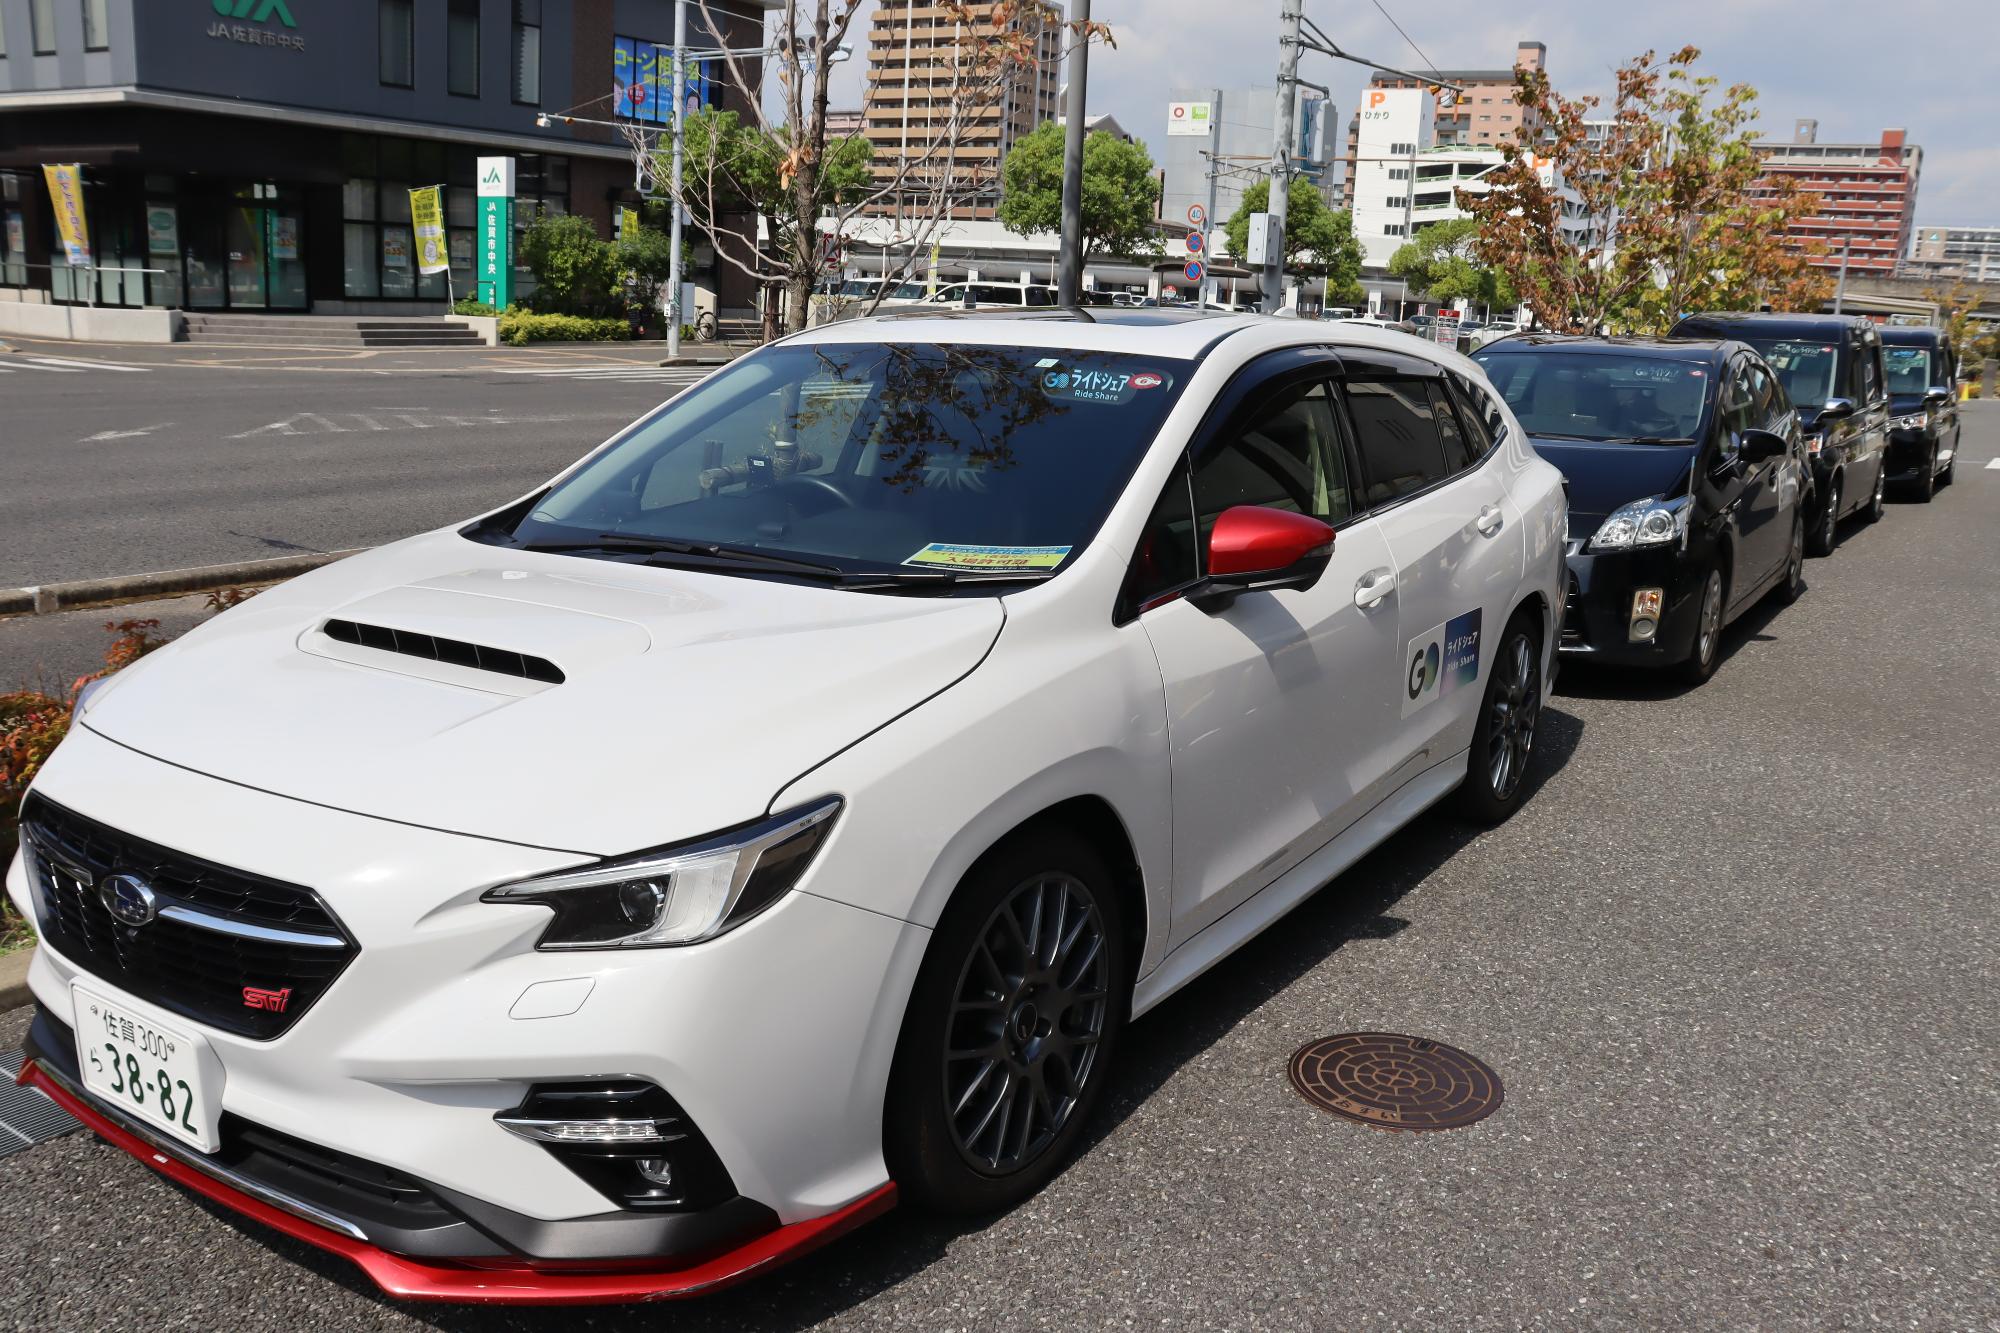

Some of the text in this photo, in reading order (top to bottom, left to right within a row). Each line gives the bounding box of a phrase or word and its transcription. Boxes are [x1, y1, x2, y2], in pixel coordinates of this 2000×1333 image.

[1371, 92, 1386, 108] P
[1364, 111, 1390, 120] ひかり
[1191, 209, 1201, 218] 40
[1071, 369, 1131, 392] ライドシェア
[1074, 390, 1119, 401] Ride Share
[1447, 631, 1478, 656] ライドシェア
[1447, 653, 1475, 673] Ride Share
[105, 1042, 198, 1136] 38-82
